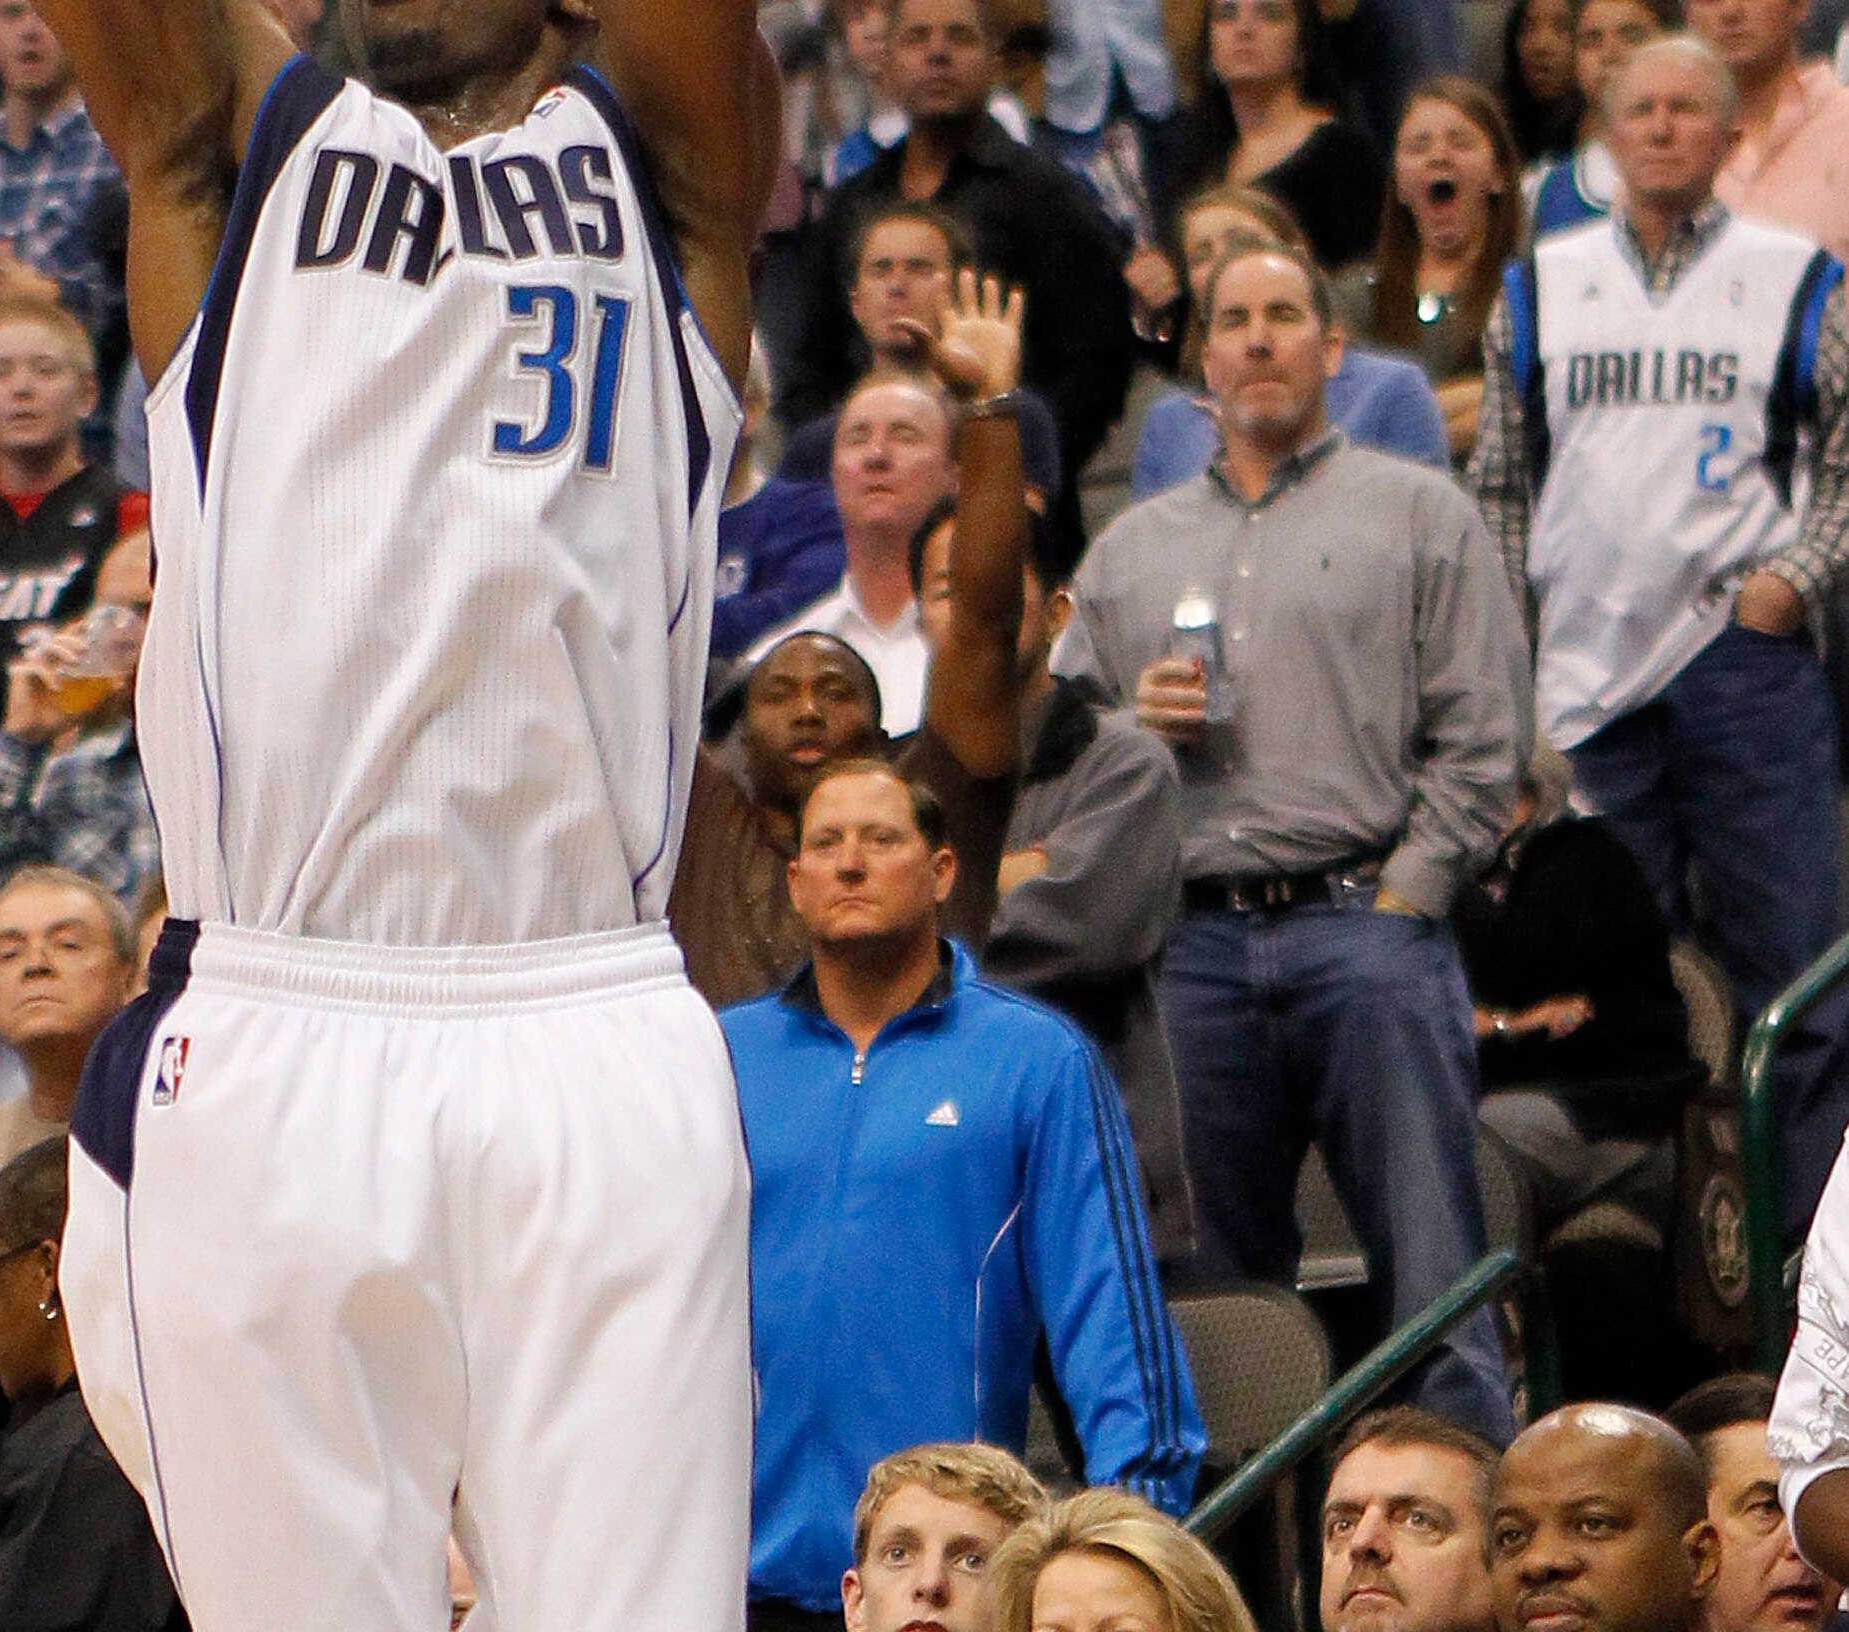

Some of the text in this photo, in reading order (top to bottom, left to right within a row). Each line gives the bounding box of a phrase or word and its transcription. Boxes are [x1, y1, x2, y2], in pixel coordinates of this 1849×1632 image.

[485, 283, 634, 478] 31
[1567, 349, 1739, 408] DALLAS
[1696, 424, 1732, 493] 2
